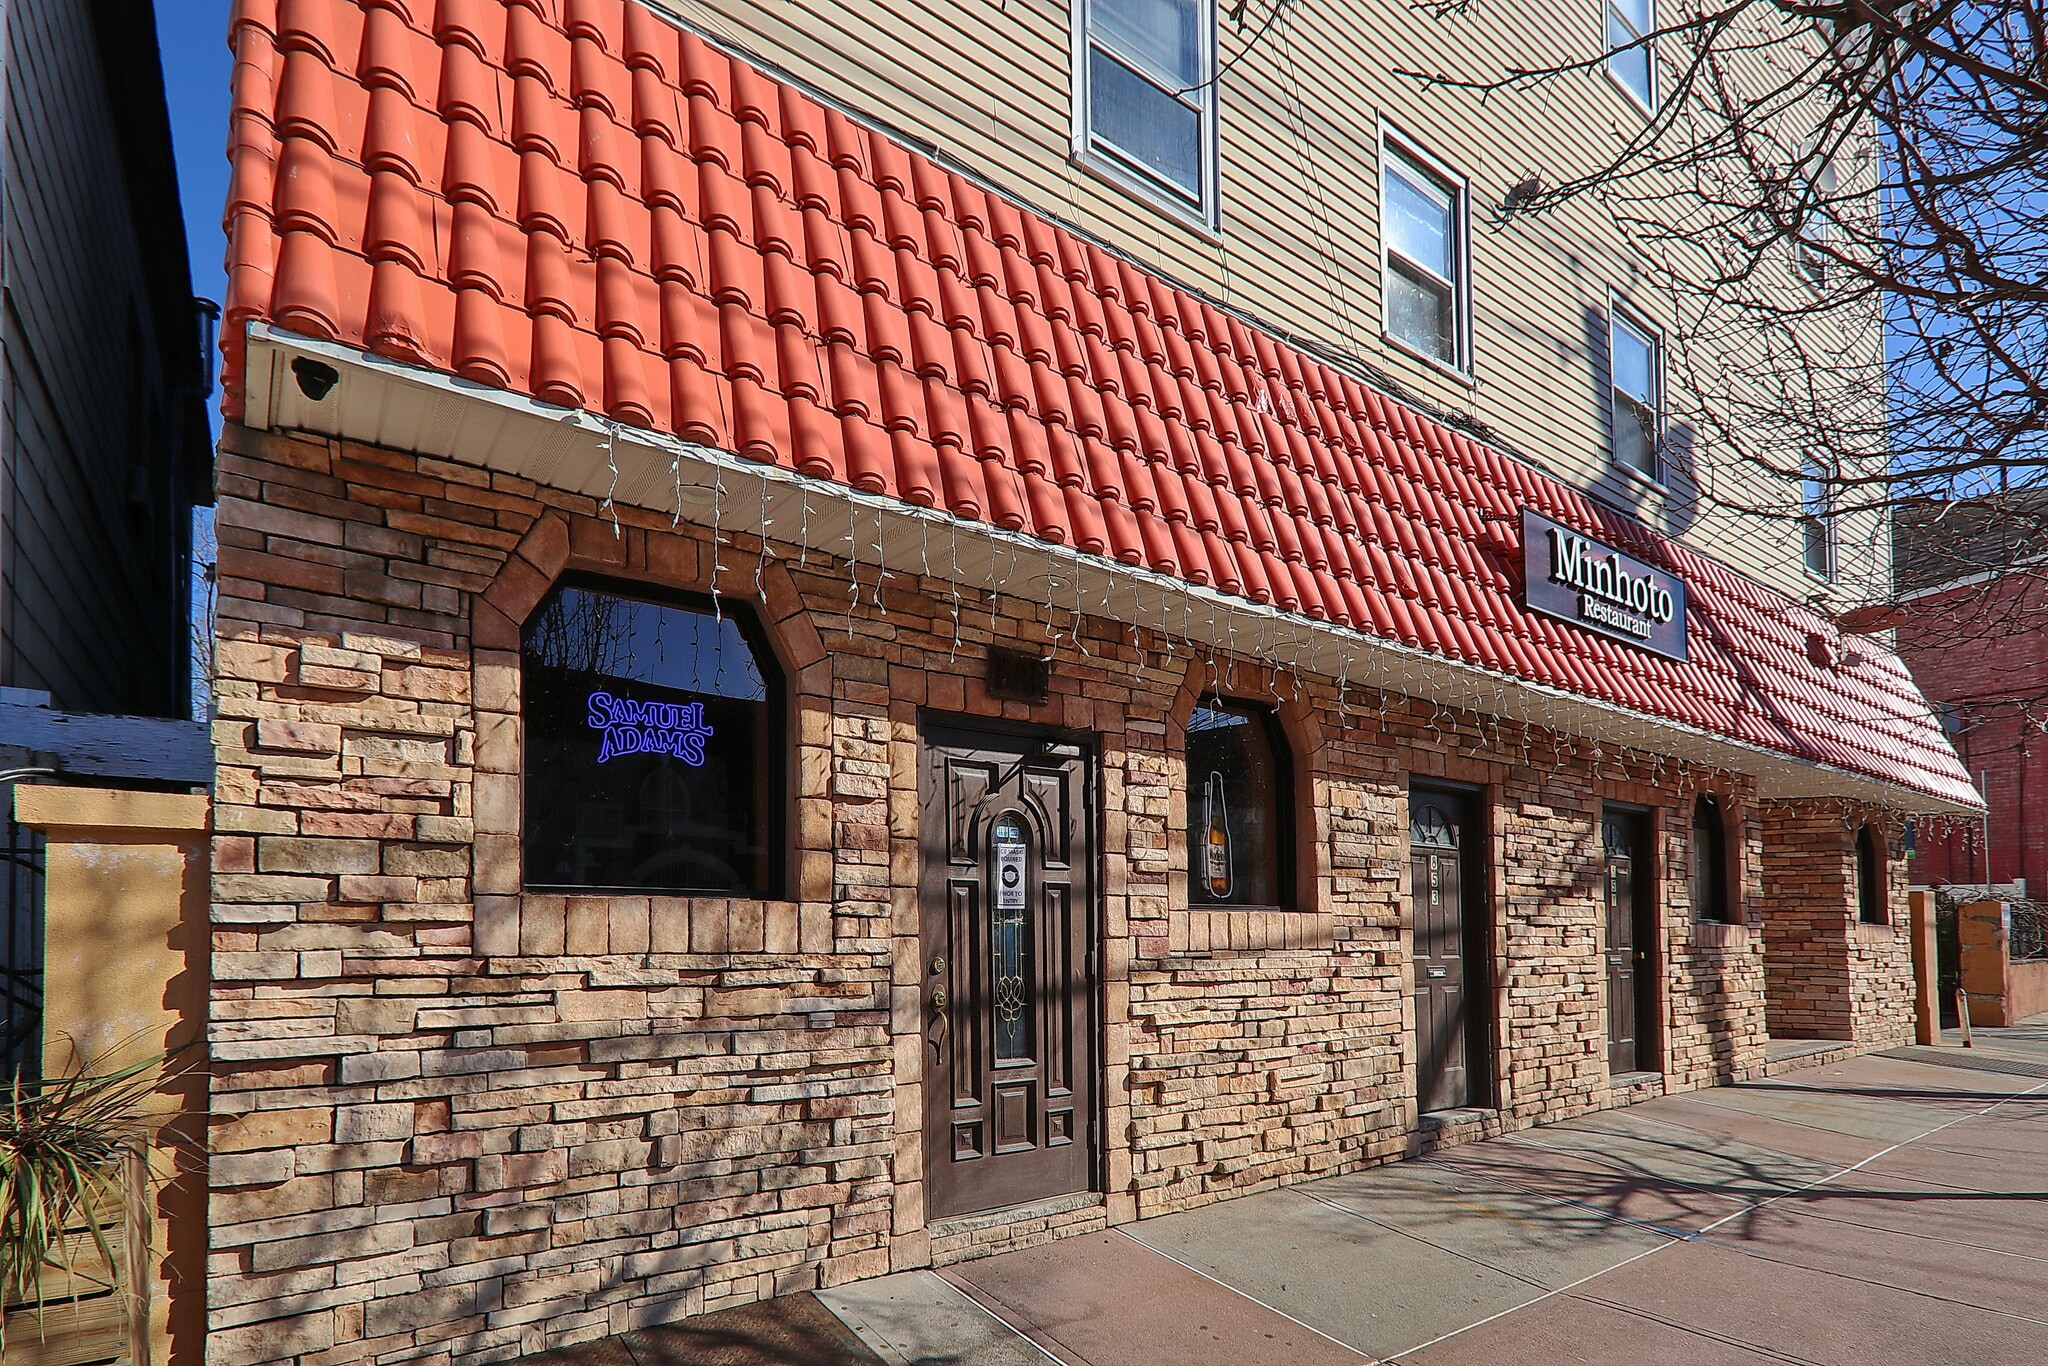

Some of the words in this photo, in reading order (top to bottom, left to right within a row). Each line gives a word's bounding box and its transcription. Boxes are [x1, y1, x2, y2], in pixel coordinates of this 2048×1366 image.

[1553, 527, 1674, 623] Minhoto
[1583, 594, 1652, 639] Restaurant
[587, 690, 714, 736] SAMUEL
[597, 726, 705, 767] ADAMS
